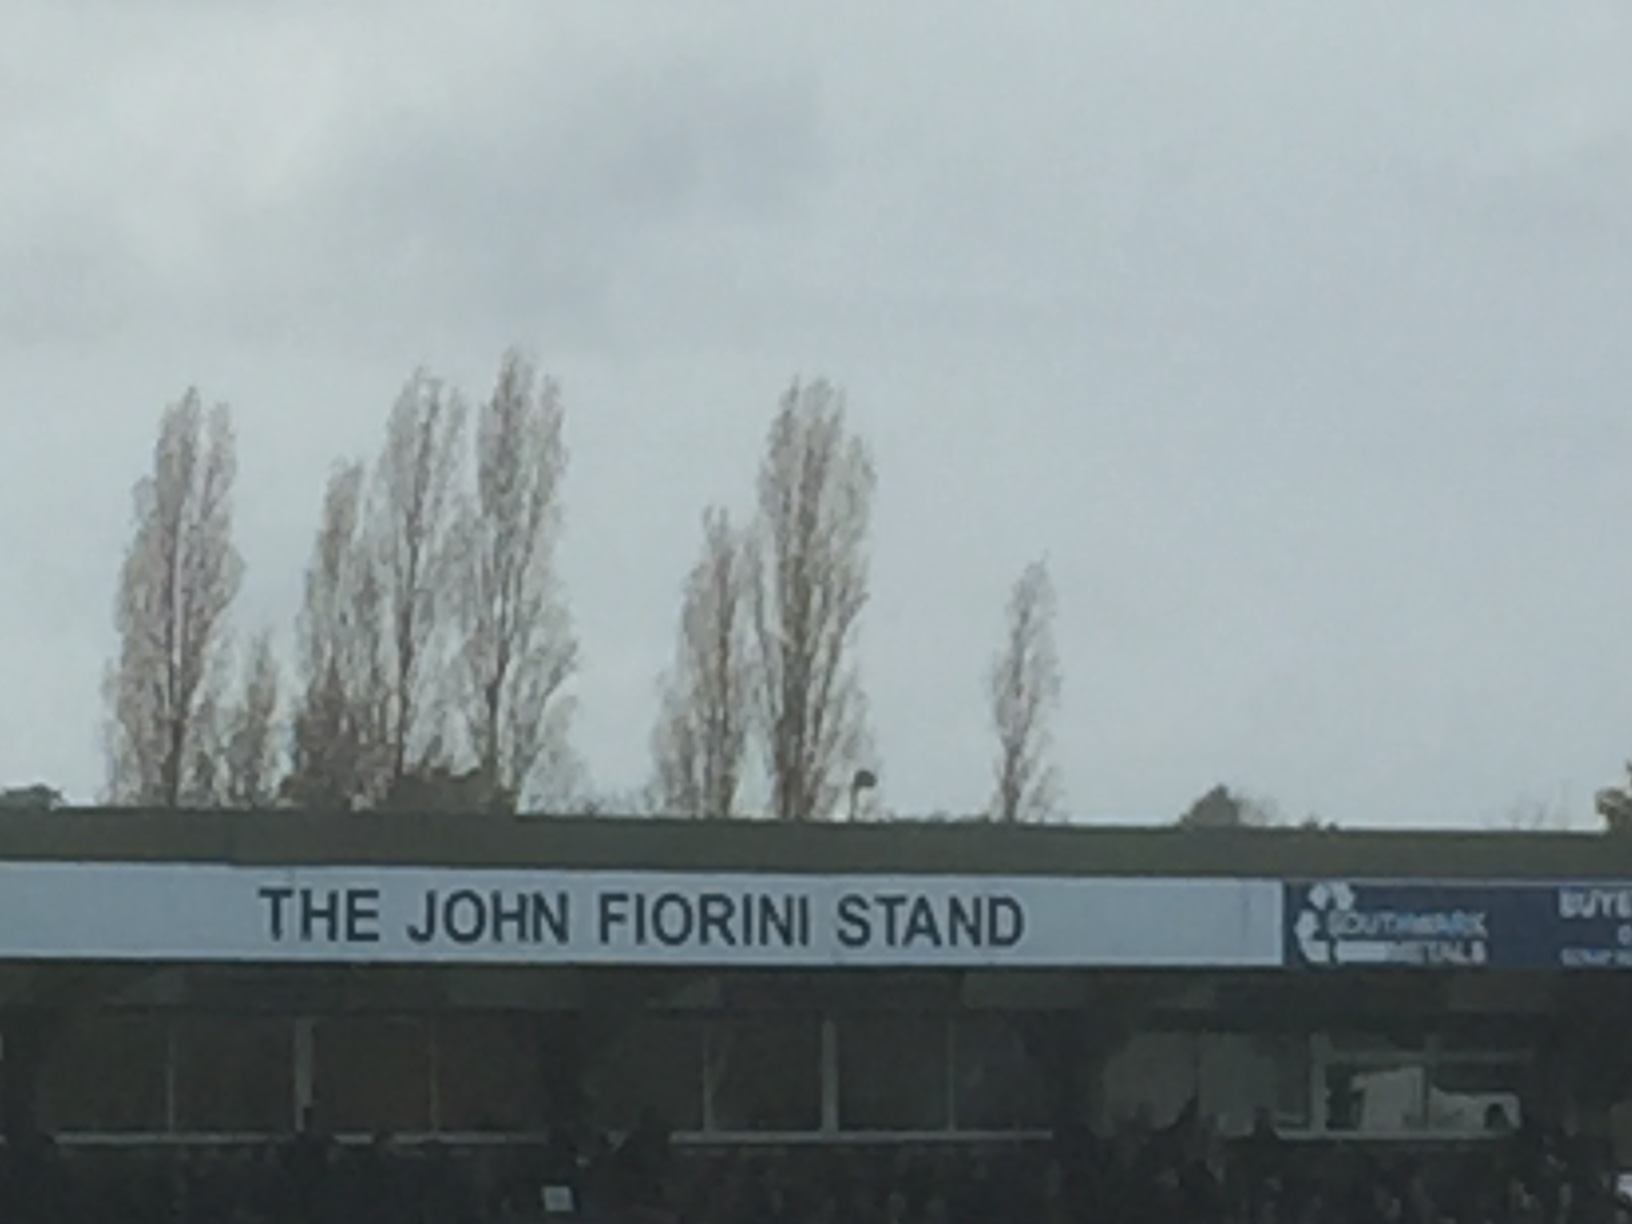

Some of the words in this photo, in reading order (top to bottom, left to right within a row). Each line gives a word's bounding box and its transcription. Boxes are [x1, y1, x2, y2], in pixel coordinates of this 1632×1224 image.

[260, 888, 381, 943] THE
[405, 889, 571, 944] JOHN
[597, 892, 810, 946] FIORINI
[836, 895, 1025, 948] STAND
